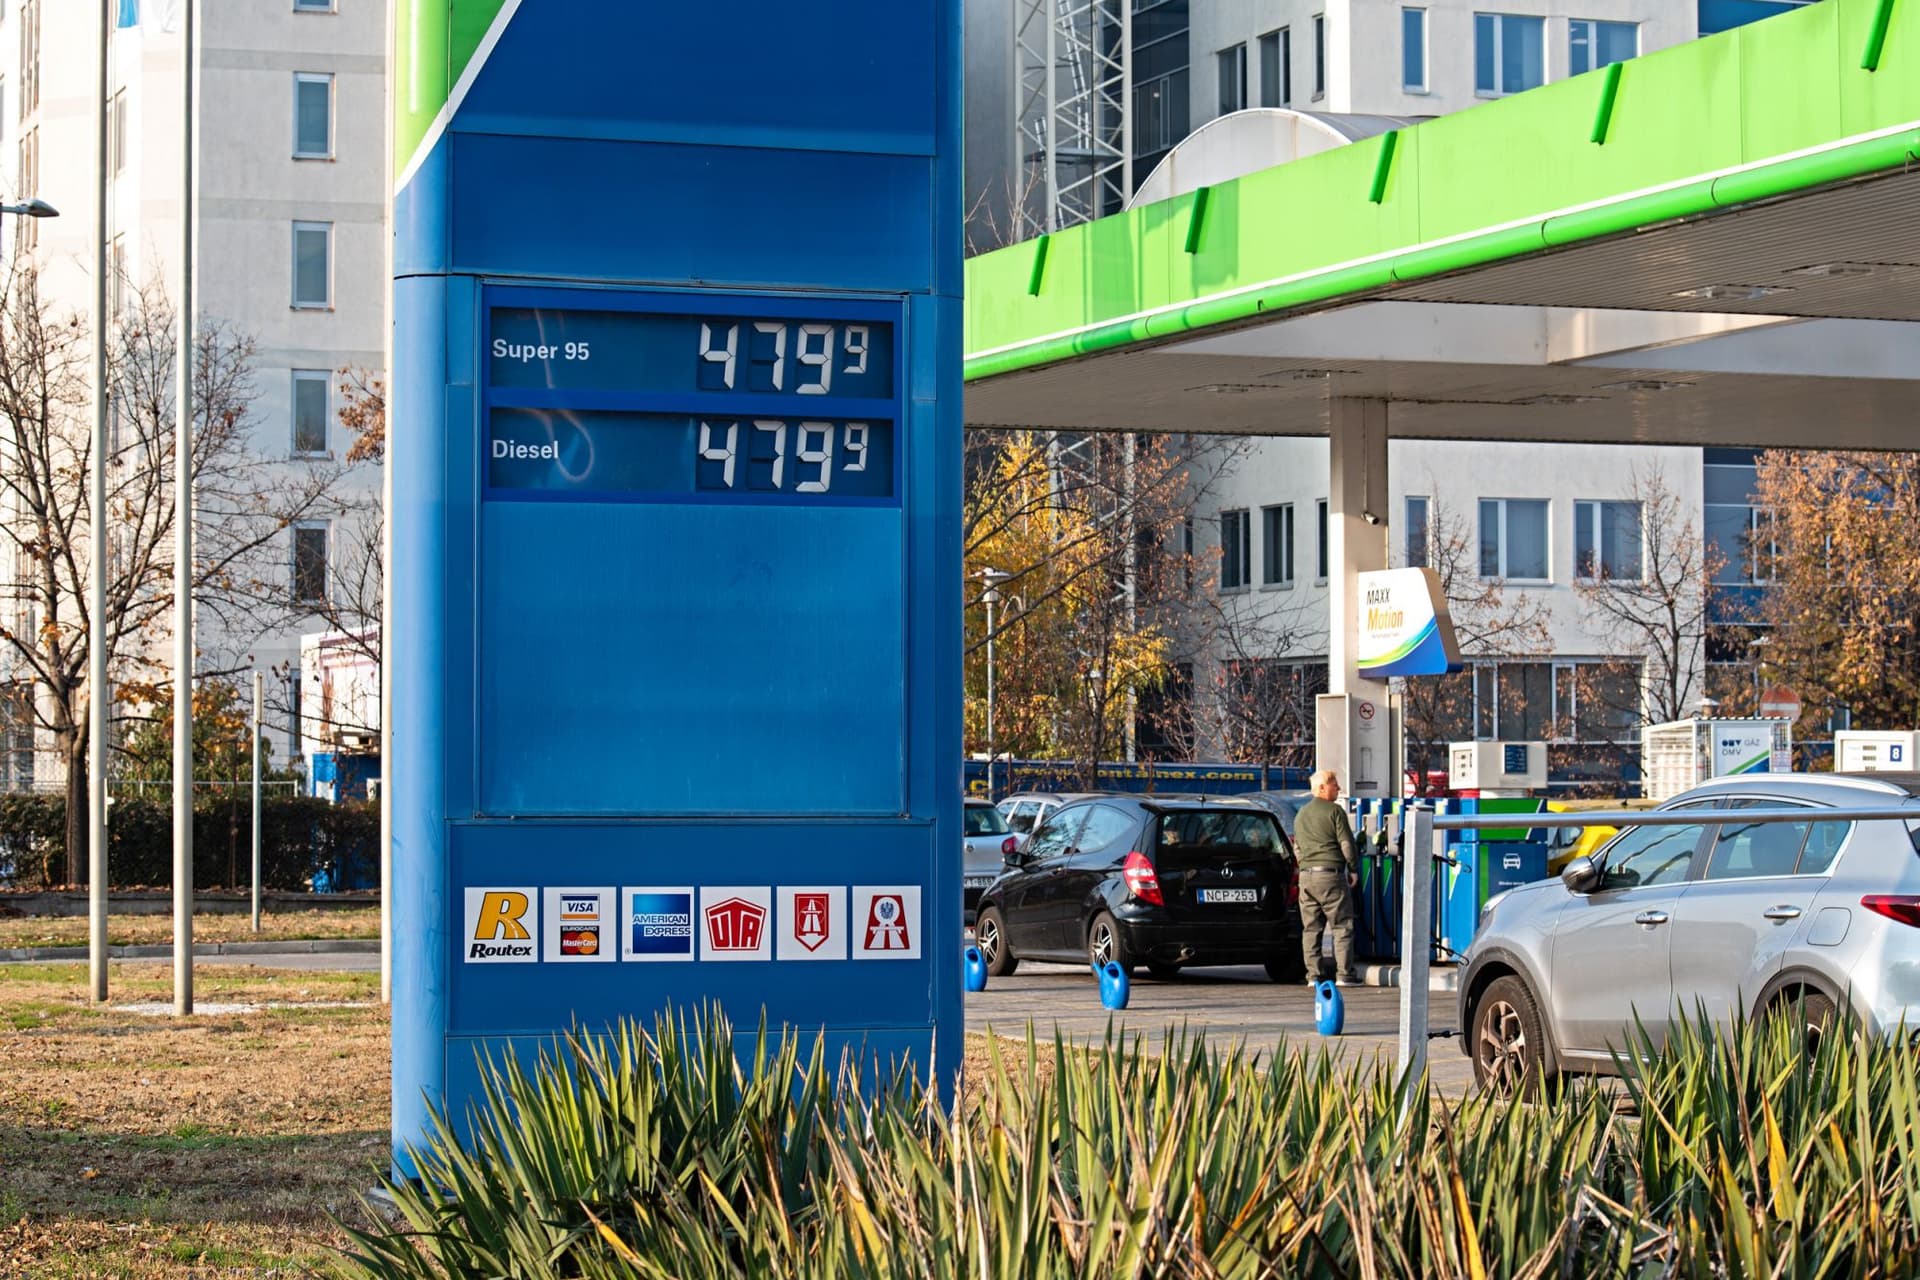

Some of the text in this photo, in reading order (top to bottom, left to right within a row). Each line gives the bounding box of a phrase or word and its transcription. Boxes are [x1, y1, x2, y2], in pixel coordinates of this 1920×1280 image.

[493, 339, 558, 363] Super
[564, 342, 590, 360] 95
[493, 439, 559, 459] Diesel
[1366, 588, 1391, 606] MAXX
[1367, 607, 1403, 632] Motion
[1892, 748, 1900, 760] 8
[1206, 890, 1255, 901] NCP-253
[567, 902, 594, 913] VISA
[632, 914, 689, 925] AMERICAN
[706, 899, 764, 948] UTA
[644, 926, 691, 936] EXPRESS
[469, 943, 533, 959] Routex
